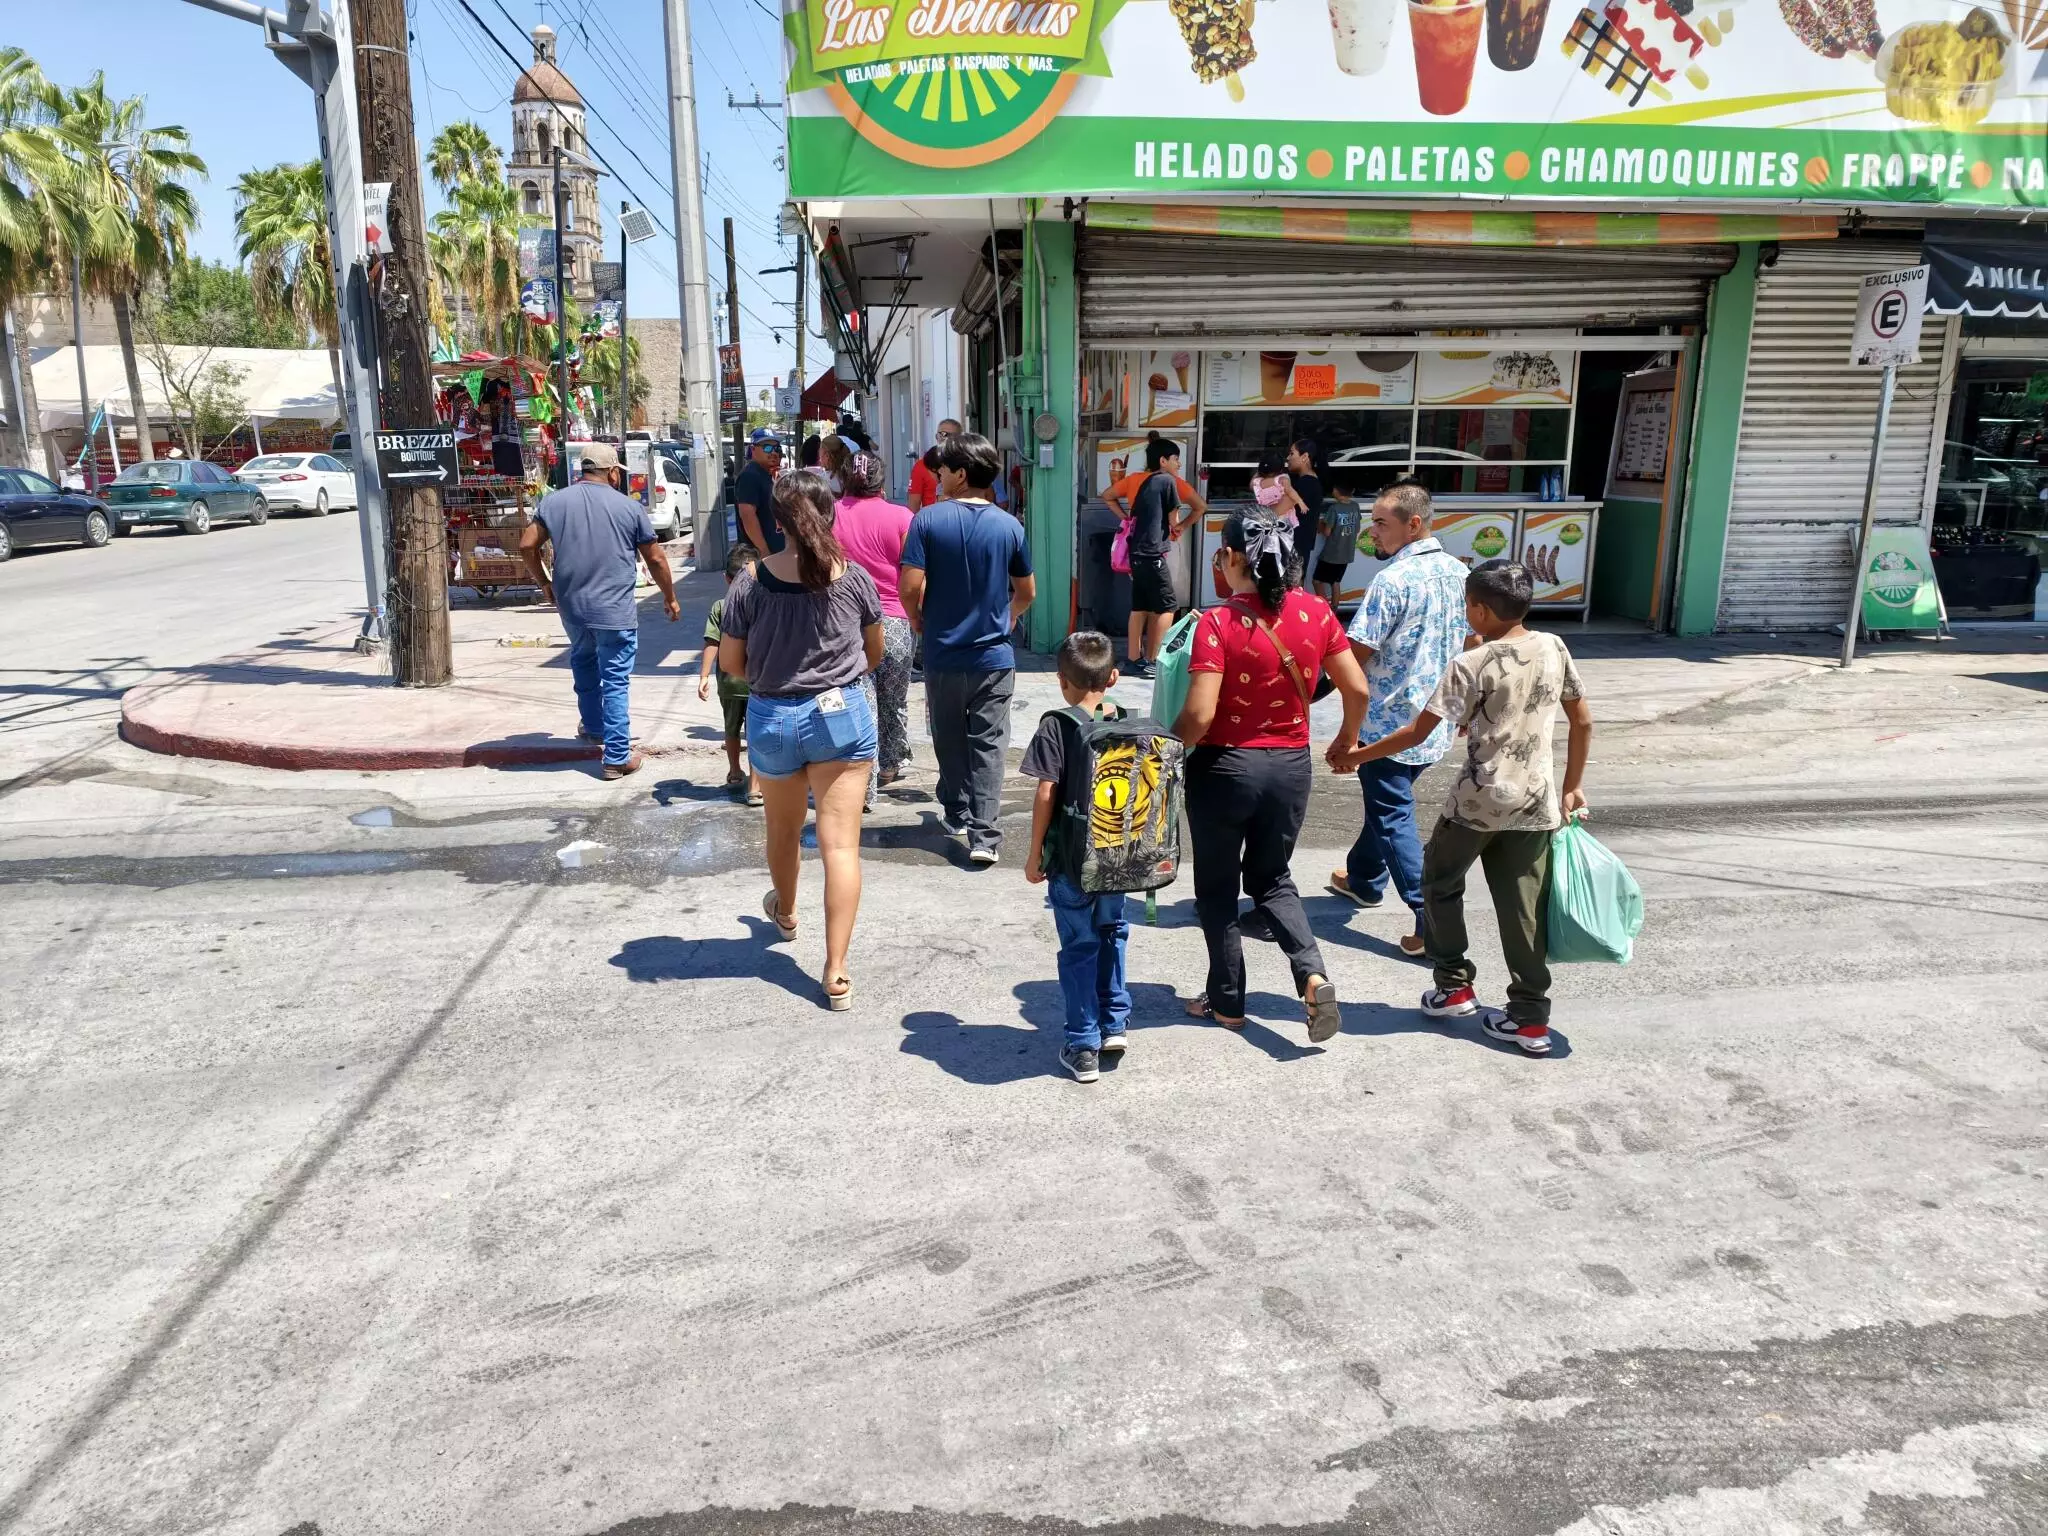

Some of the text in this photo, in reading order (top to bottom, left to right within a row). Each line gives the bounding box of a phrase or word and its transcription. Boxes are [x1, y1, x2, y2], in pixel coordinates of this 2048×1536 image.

[819, 0, 1077, 51] Las Delicias
[845, 63, 891, 83] HELADOS
[900, 57, 946, 75] PALETAS
[954, 55, 1009, 70] RASPADOS
[1016, 56, 1022, 70] Y
[1134, 141, 1298, 180] HELADOS
[1345, 145, 1496, 182] PALETAS
[1540, 147, 1799, 187] CHAMOQUINES
[1842, 149, 1965, 190] FRAPPÉ
[1865, 269, 1924, 287] EXCLUSIVO
[1880, 299, 1901, 329] E
[377, 433, 454, 450] BREZZE
[400, 450, 436, 462] BOUTIQUE
